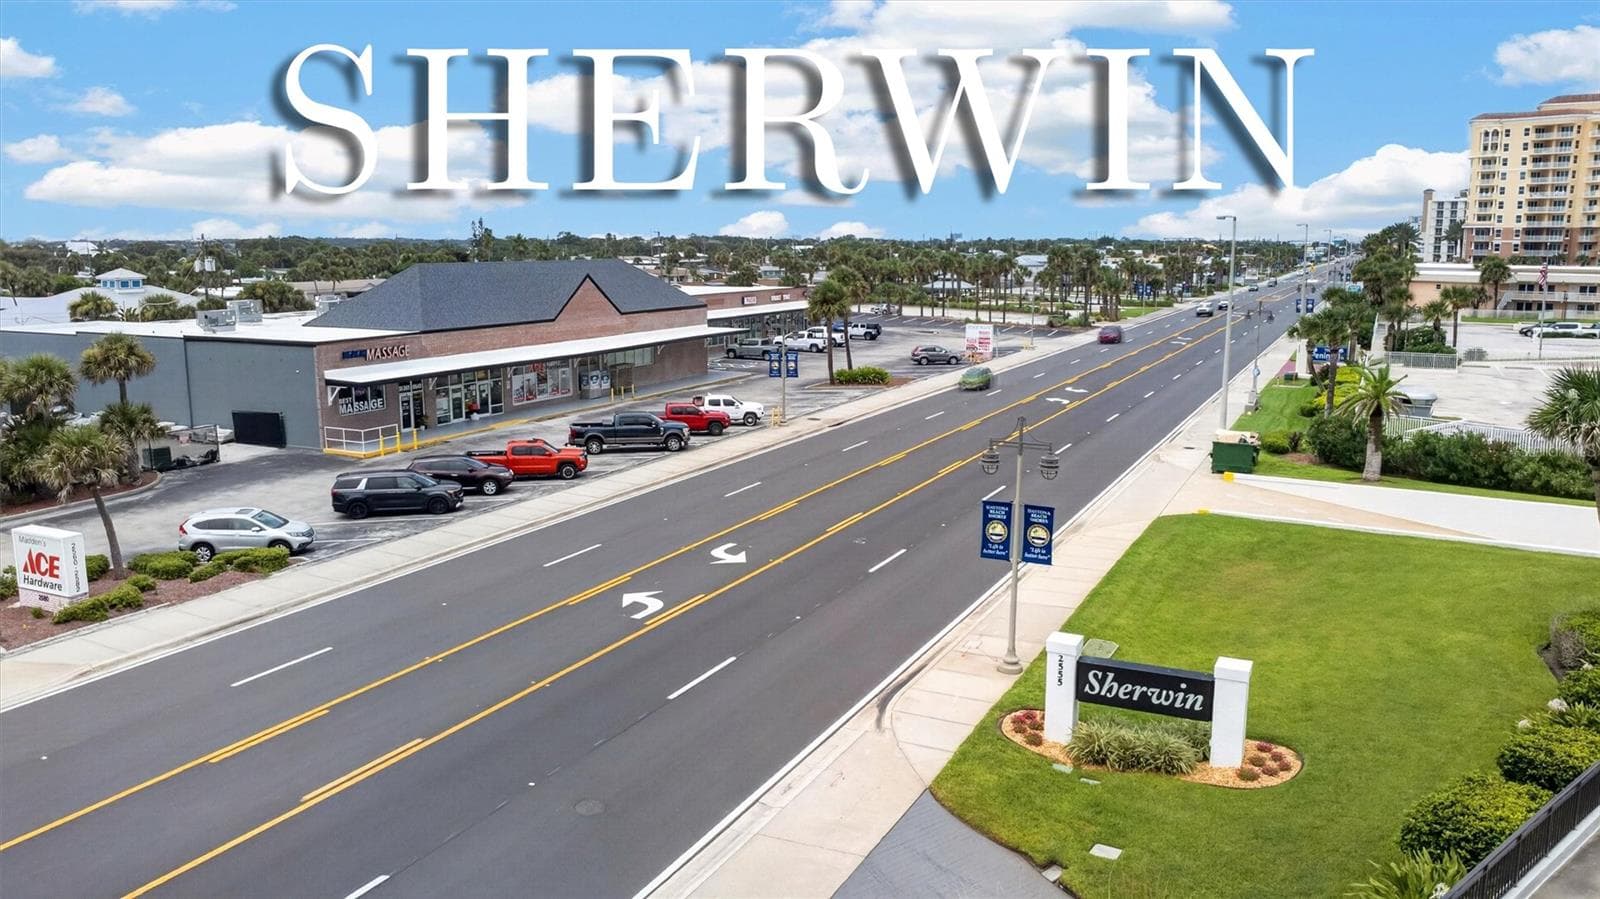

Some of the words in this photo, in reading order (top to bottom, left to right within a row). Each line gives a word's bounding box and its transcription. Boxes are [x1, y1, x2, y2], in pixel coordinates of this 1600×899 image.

[367, 345, 410, 360] MASSAGE
[340, 399, 384, 414] MASSAGE
[23, 547, 60, 579] ACE
[23, 574, 63, 592] Hardware
[1084, 669, 1204, 711] Sherwin
